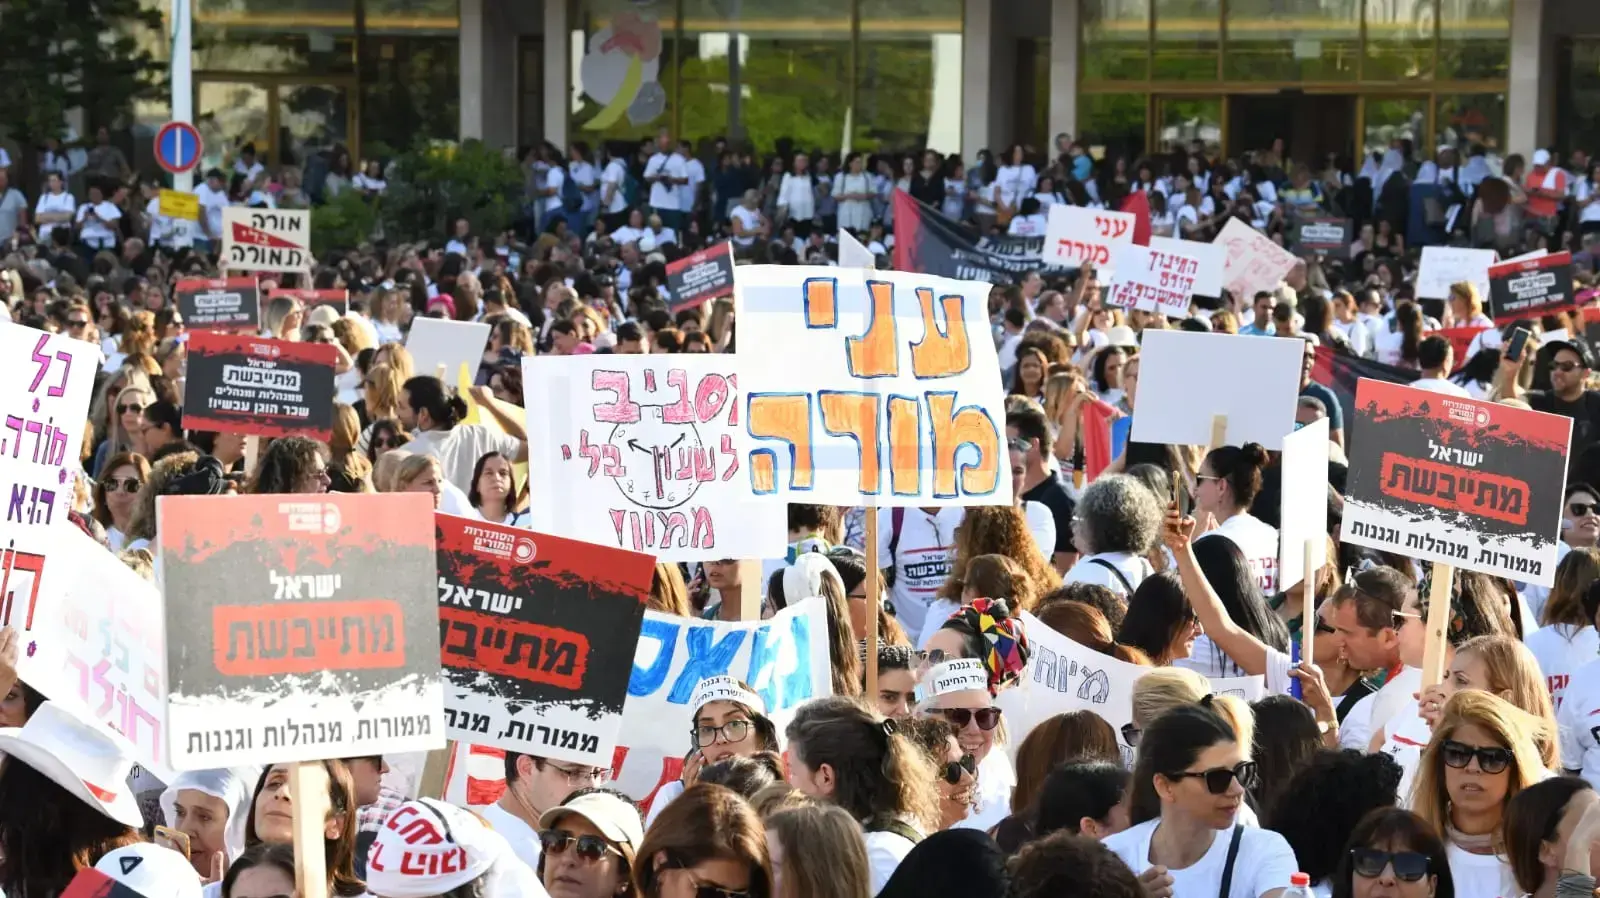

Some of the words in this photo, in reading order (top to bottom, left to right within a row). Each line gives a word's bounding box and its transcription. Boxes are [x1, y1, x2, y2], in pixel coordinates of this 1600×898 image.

[1094, 215, 1129, 239] עני
[1056, 238, 1110, 265] מורה
[802, 276, 972, 380] עני
[28, 333, 73, 398] כל
[247, 357, 277, 367] ישראל
[228, 369, 298, 387] מתייבשת
[208, 397, 250, 411] עכשיו!
[254, 402, 279, 415] הוגן
[283, 404, 310, 417] שכר
[747, 389, 1001, 499] מורה
[1428, 439, 1484, 468] ישראל
[1387, 462, 1523, 515] מתייבשת
[7, 483, 56, 525] הוא
[464, 525, 516, 543] הסתדרות
[474, 536, 514, 552] המורים
[1351, 520, 1400, 544] וגננות
[1405, 532, 1469, 560] מנהלות
[907, 563, 953, 577] תייבשת
[1473, 549, 1543, 577] ממורות,
[269, 569, 342, 600] ישראל
[438, 577, 523, 615] ישראל
[225, 613, 396, 662] מתייבשת
[440, 618, 579, 677] מתייב
[937, 676, 968, 690] החינוך
[263, 718, 343, 749] מנהלות
[351, 713, 432, 745] ממורות,
[443, 707, 491, 734] מנה
[186, 728, 253, 754] וגננות
[497, 719, 600, 754] ממורות,
